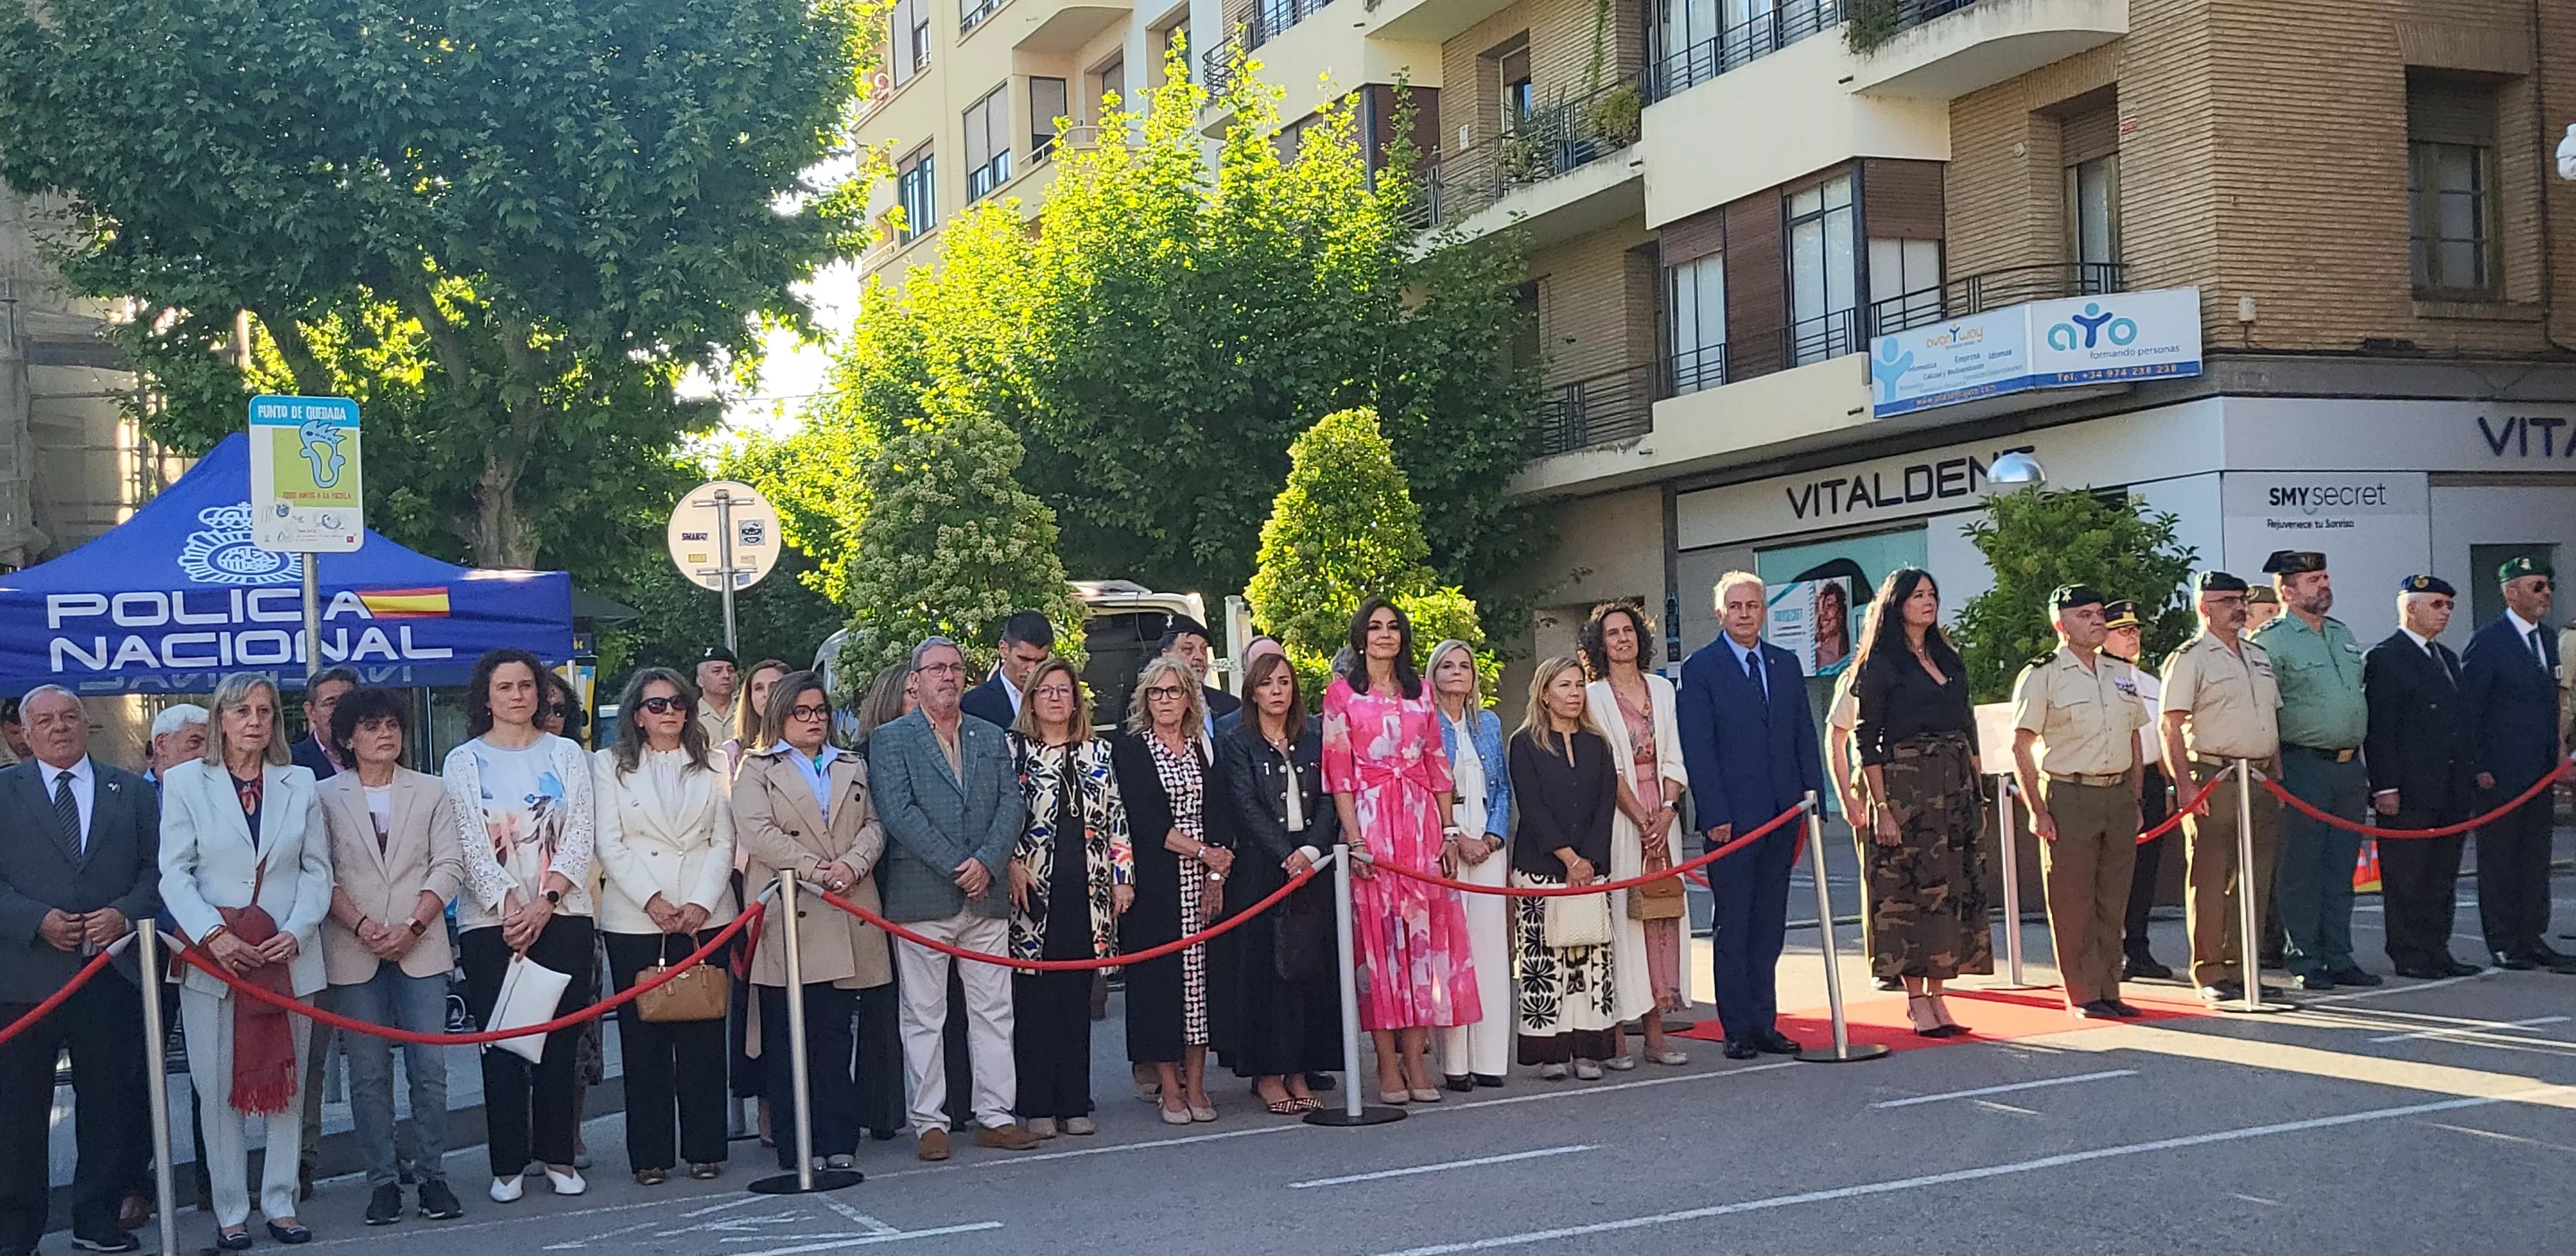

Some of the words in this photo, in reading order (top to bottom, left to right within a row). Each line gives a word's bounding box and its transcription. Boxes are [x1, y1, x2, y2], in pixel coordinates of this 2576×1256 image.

[2090, 348, 2135, 359] formando
[2138, 344, 2180, 357] personas
[2106, 368, 2127, 377] 974
[257, 405, 288, 419] PUNTO
[291, 406, 303, 419] DE
[306, 406, 347, 420] QUEDADA
[2267, 519, 2312, 530] Rejuvenece
[2315, 520, 2323, 528] tu
[47, 588, 373, 629] POLICA
[49, 626, 453, 672] NACIONAL
